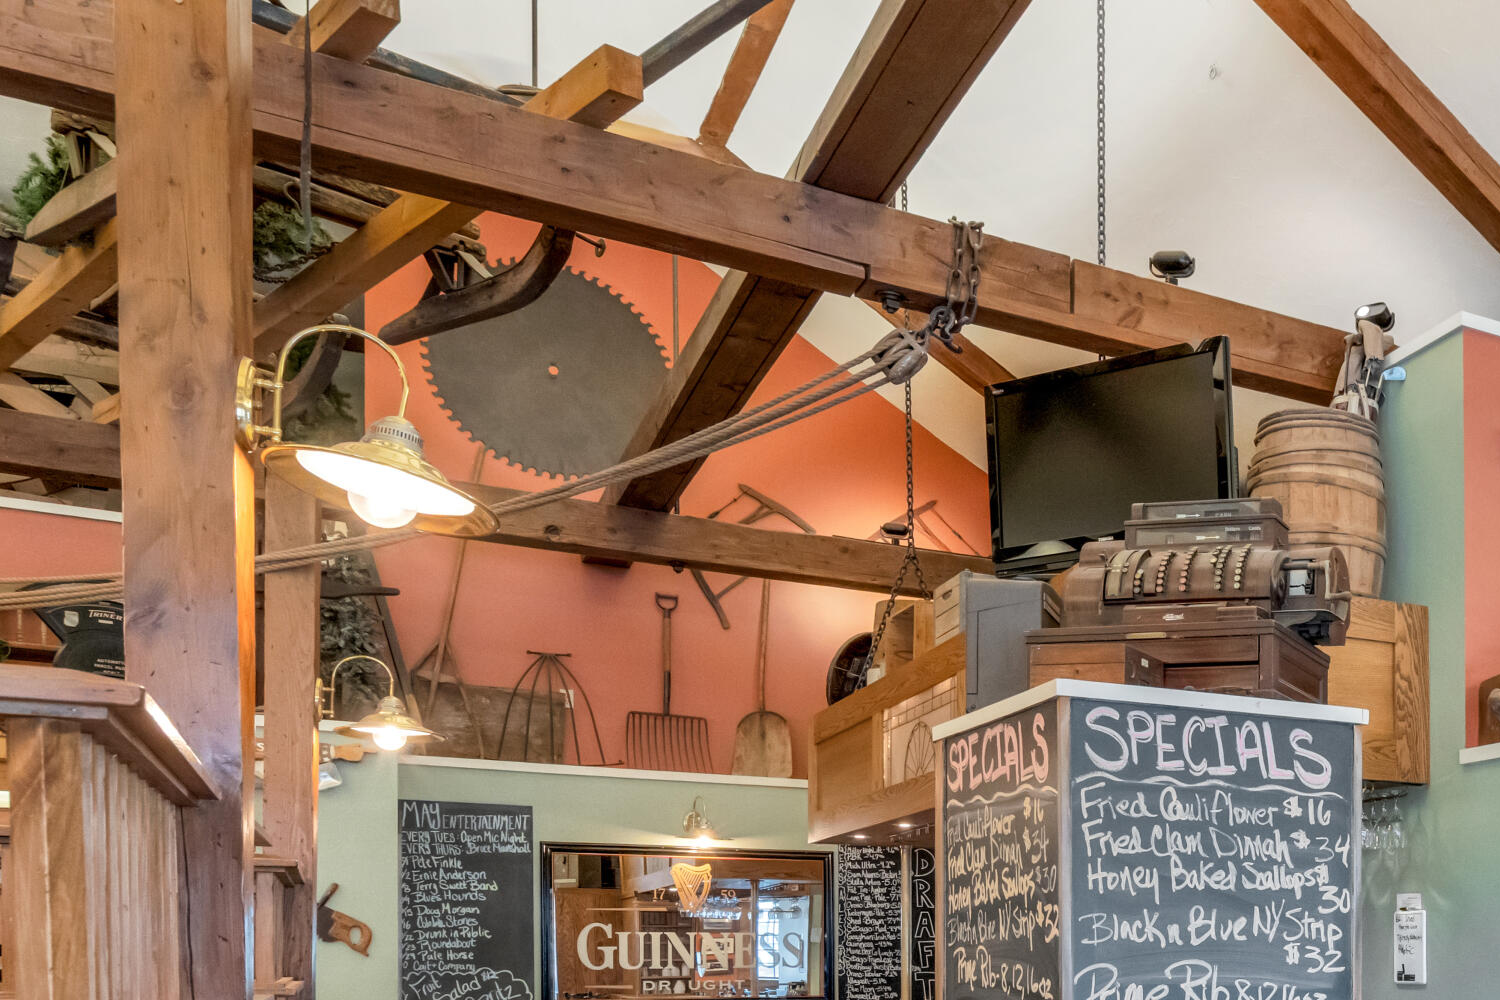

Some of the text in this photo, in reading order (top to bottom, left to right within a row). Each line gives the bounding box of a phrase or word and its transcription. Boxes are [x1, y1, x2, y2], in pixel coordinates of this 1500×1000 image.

[947, 713, 1048, 792] SPECIALS
[1085, 706, 1332, 789] SPECIALS
[1080, 782, 1157, 819] Fried
[1160, 786, 1279, 827] Cauliflower
[402, 801, 531, 831] MAY ENTERTAINMENT
[461, 831, 482, 843] Open
[484, 831, 499, 841] Mic
[501, 831, 527, 844] Night
[1082, 818, 1151, 857] Fried
[1151, 824, 1203, 859] Clam
[412, 855, 431, 869] Pete
[431, 856, 462, 869] Finkle
[412, 869, 439, 881] Ernie
[440, 869, 487, 880] Anderson
[1088, 858, 1160, 904] Honey
[1170, 854, 1237, 892] Baked
[411, 891, 442, 902] Blues
[444, 890, 486, 901] Hounds
[414, 881, 438, 895] Terry
[467, 880, 498, 891] Band
[652, 888, 736, 901] 17 59
[413, 904, 440, 917] Doug
[441, 903, 480, 915] Morgan
[914, 848, 936, 1000] DRAFT
[1012, 905, 1035, 951] Strip
[1188, 905, 1248, 946] Blue
[1253, 899, 1285, 943] NY
[413, 929, 448, 940] Drunk
[450, 929, 459, 938] in
[459, 926, 492, 938] Public
[416, 939, 476, 951] Roundabout
[577, 922, 804, 970] GUINNESS
[418, 950, 442, 961] Pale
[446, 950, 474, 960] Horse
[438, 961, 475, 972] Company
[409, 975, 441, 1000] Fruit
